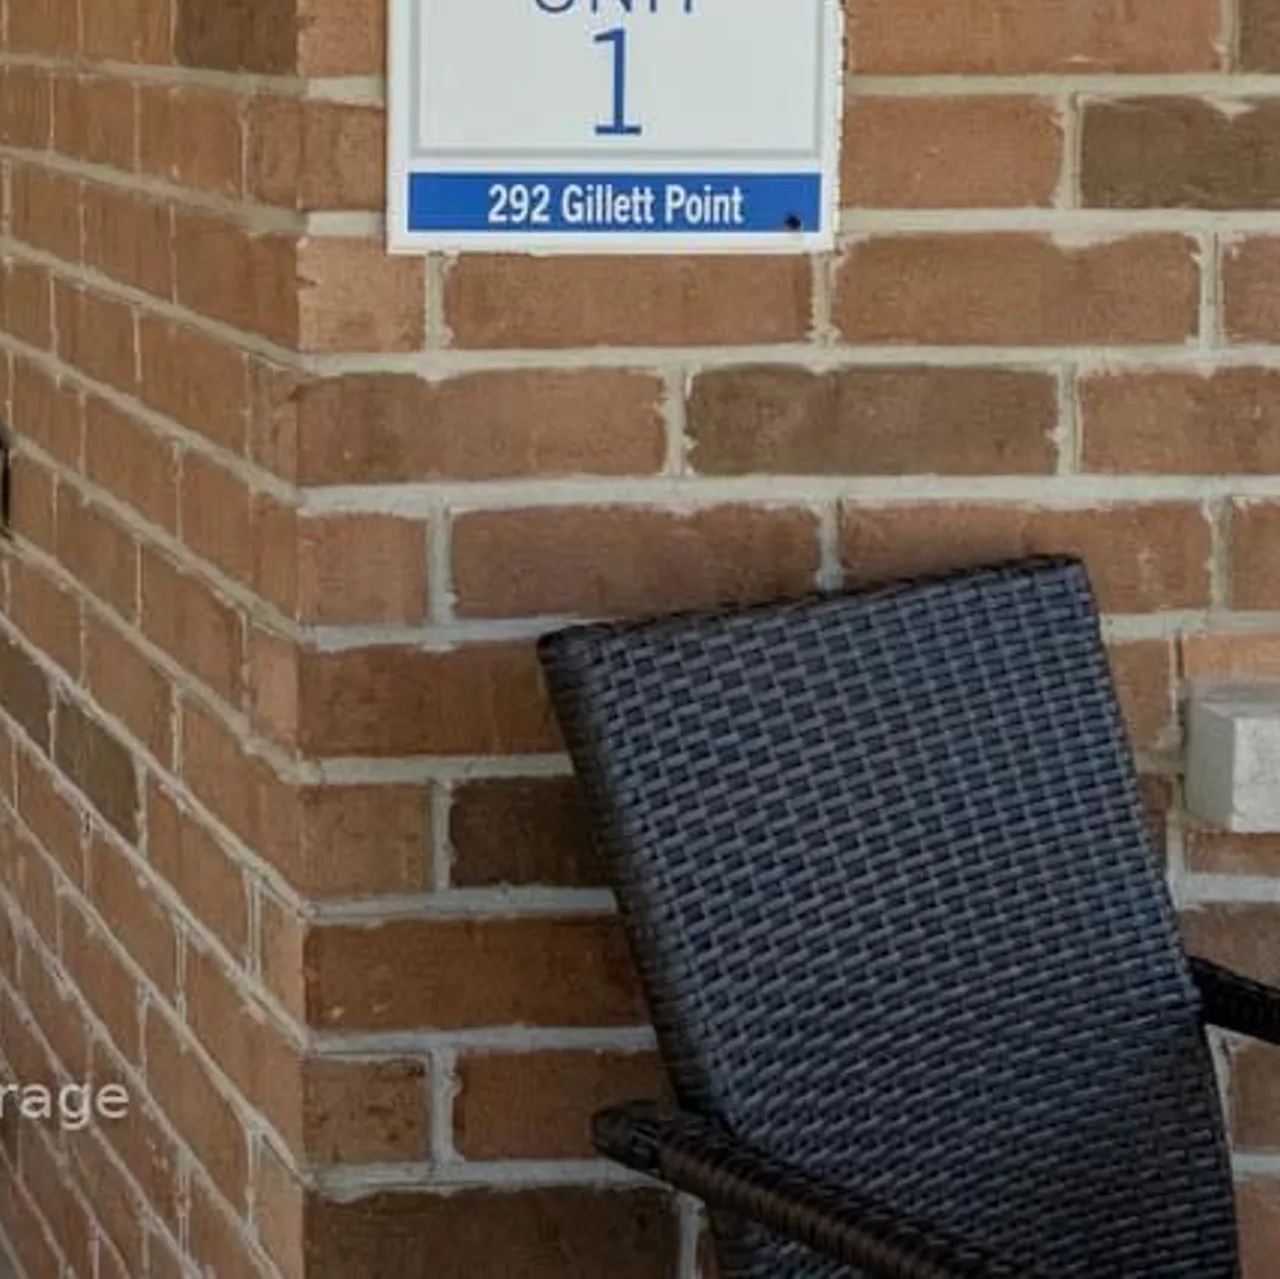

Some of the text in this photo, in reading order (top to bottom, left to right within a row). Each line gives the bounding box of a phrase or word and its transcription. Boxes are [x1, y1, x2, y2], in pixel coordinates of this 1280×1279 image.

[592, 26, 642, 136] 1
[487, 183, 745, 224] 292 Gillett Point
